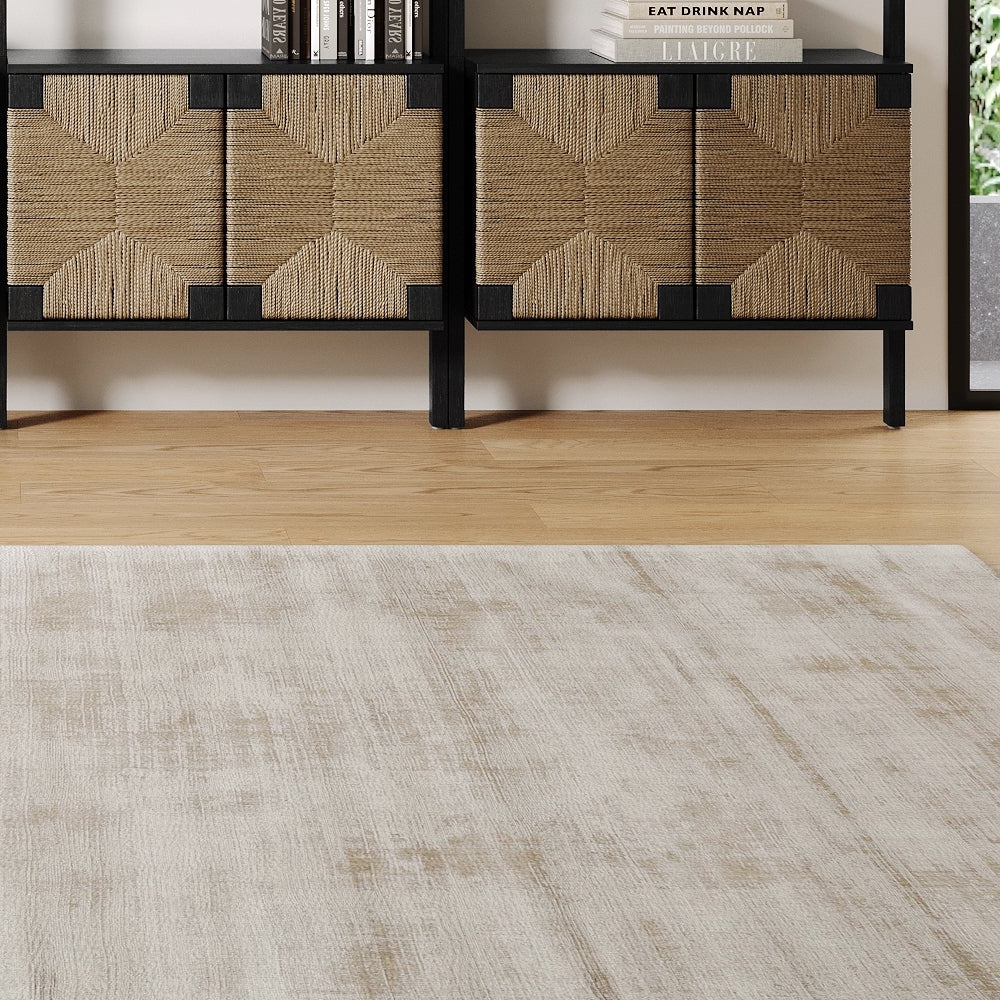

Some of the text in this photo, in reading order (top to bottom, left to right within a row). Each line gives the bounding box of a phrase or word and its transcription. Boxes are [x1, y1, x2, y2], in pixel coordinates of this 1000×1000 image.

[648, 6, 765, 16] EAT DRINK NAP
[366, 8, 375, 34] Dior
[654, 24, 694, 34] PAINTING
[696, 24, 732, 34] BEYOND
[734, 24, 774, 34] POLLOCK
[662, 41, 757, 61] LIAIGRE
